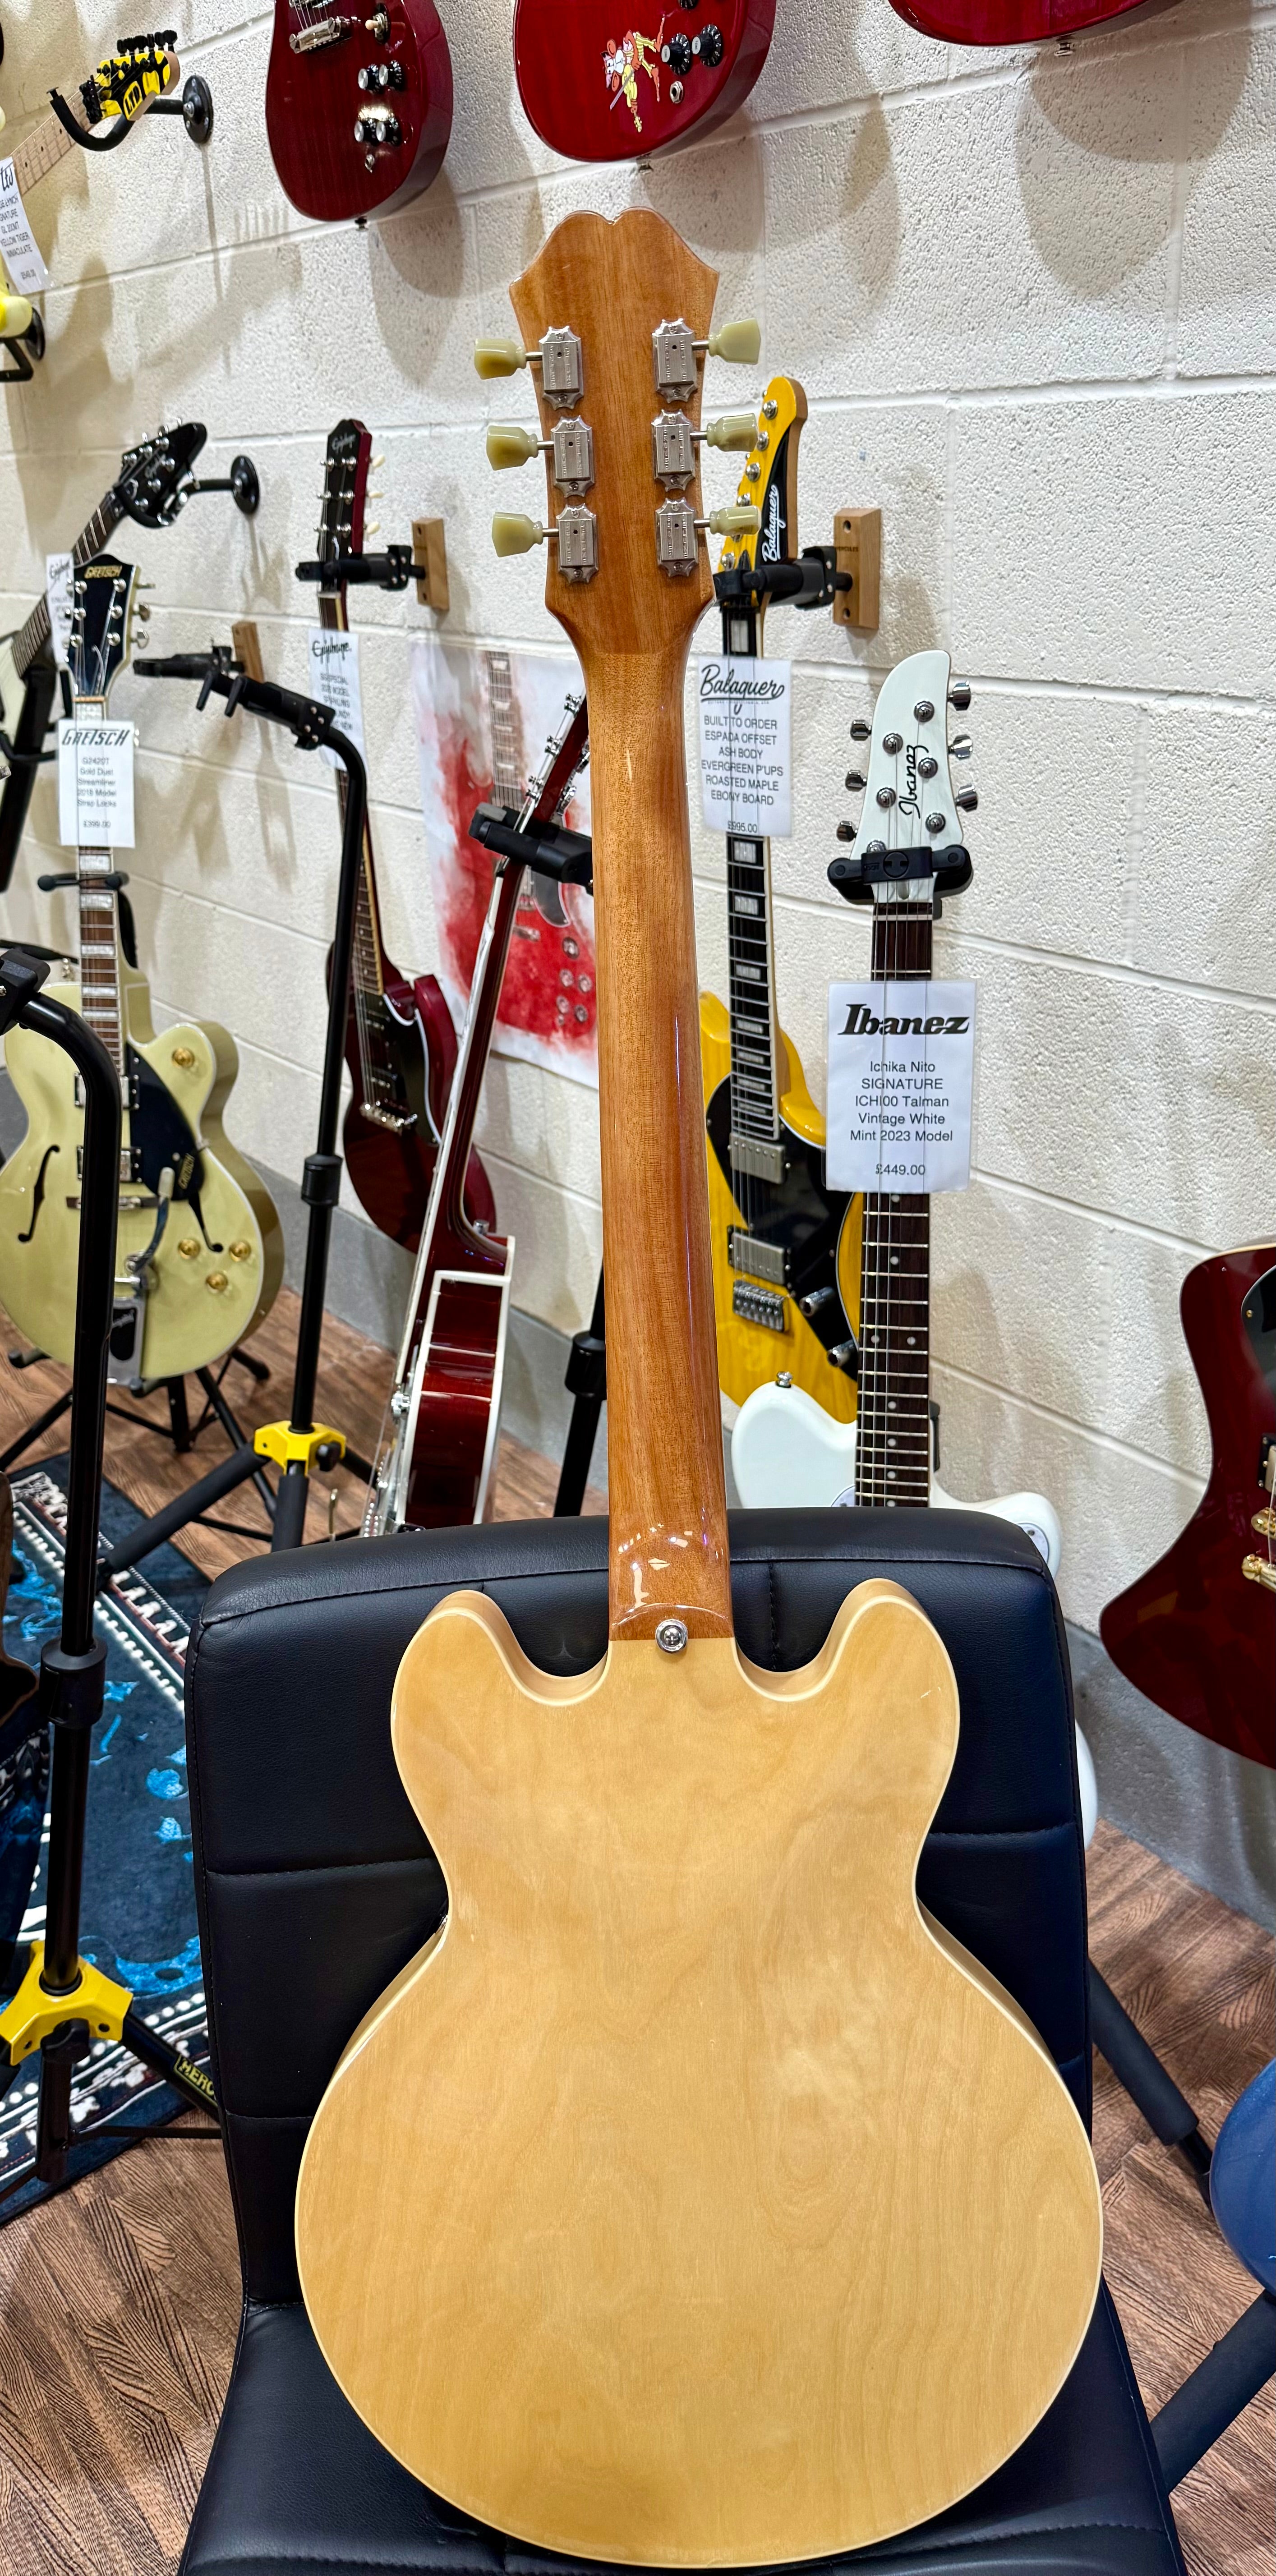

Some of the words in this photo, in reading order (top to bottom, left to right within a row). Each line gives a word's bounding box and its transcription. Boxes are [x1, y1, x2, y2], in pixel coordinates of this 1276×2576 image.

[125, 85, 140, 115] LTD
[761, 484, 786, 562] Balaguer
[84, 565, 123, 579] GRETSCH
[311, 635, 350, 665] Epiphone
[700, 664, 785, 715] Balaguer
[704, 715, 728, 727] BUILT
[728, 716, 743, 727] TO
[744, 718, 778, 730] ORDER
[62, 729, 130, 746] GRETSCH
[705, 730, 740, 743] ESPADA
[741, 733, 777, 745] OFFSET
[718, 746, 736, 758] ASH
[738, 748, 763, 760] BODY
[701, 759, 754, 774] EVERGREEN
[756, 764, 784, 777] P'UPS
[705, 774, 746, 788] ROASTED
[748, 778, 779, 791] MAPLE
[898, 745, 929, 819] Ibanez
[711, 789, 740, 801] EBONY
[742, 792, 774, 806] BOARD
[837, 1003, 970, 1035] Ibanez
[870, 1061, 906, 1072] Ichika
[910, 1061, 935, 1072] Nito
[861, 1078, 943, 1090] SIGNATURE
[902, 1095, 949, 1107] Talman
[858, 1113, 905, 1127] Vintage
[909, 1113, 945, 1124] White
[850, 1130, 876, 1141] Mint
[880, 1130, 911, 1141] 2023
[915, 1130, 953, 1142] Model
[875, 1164, 926, 1176] £449.00
[178, 2056, 215, 2096] HERC
